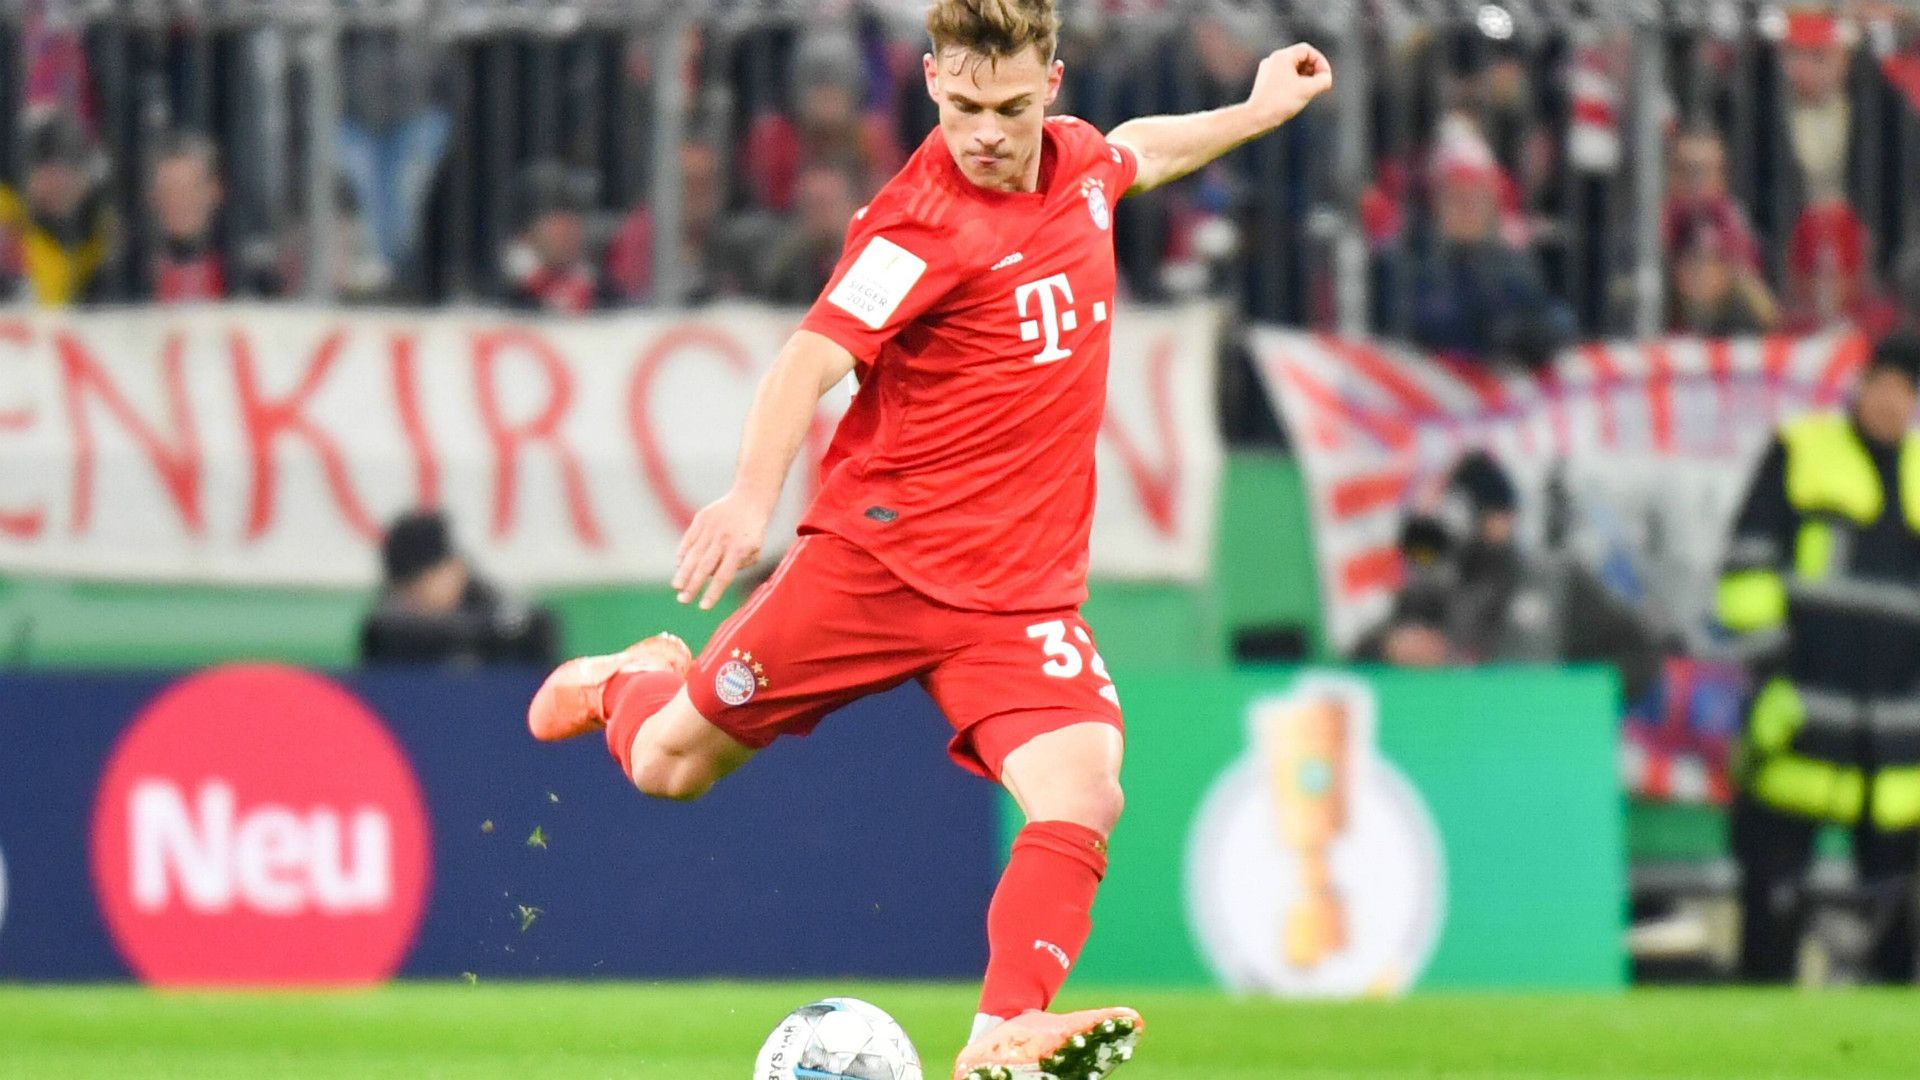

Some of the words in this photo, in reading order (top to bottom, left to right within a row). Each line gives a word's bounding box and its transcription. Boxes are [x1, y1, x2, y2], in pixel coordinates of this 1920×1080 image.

[847, 293, 875, 312] 2019
[848, 280, 888, 307] SIEGER
[128, 776, 393, 913] Neu
